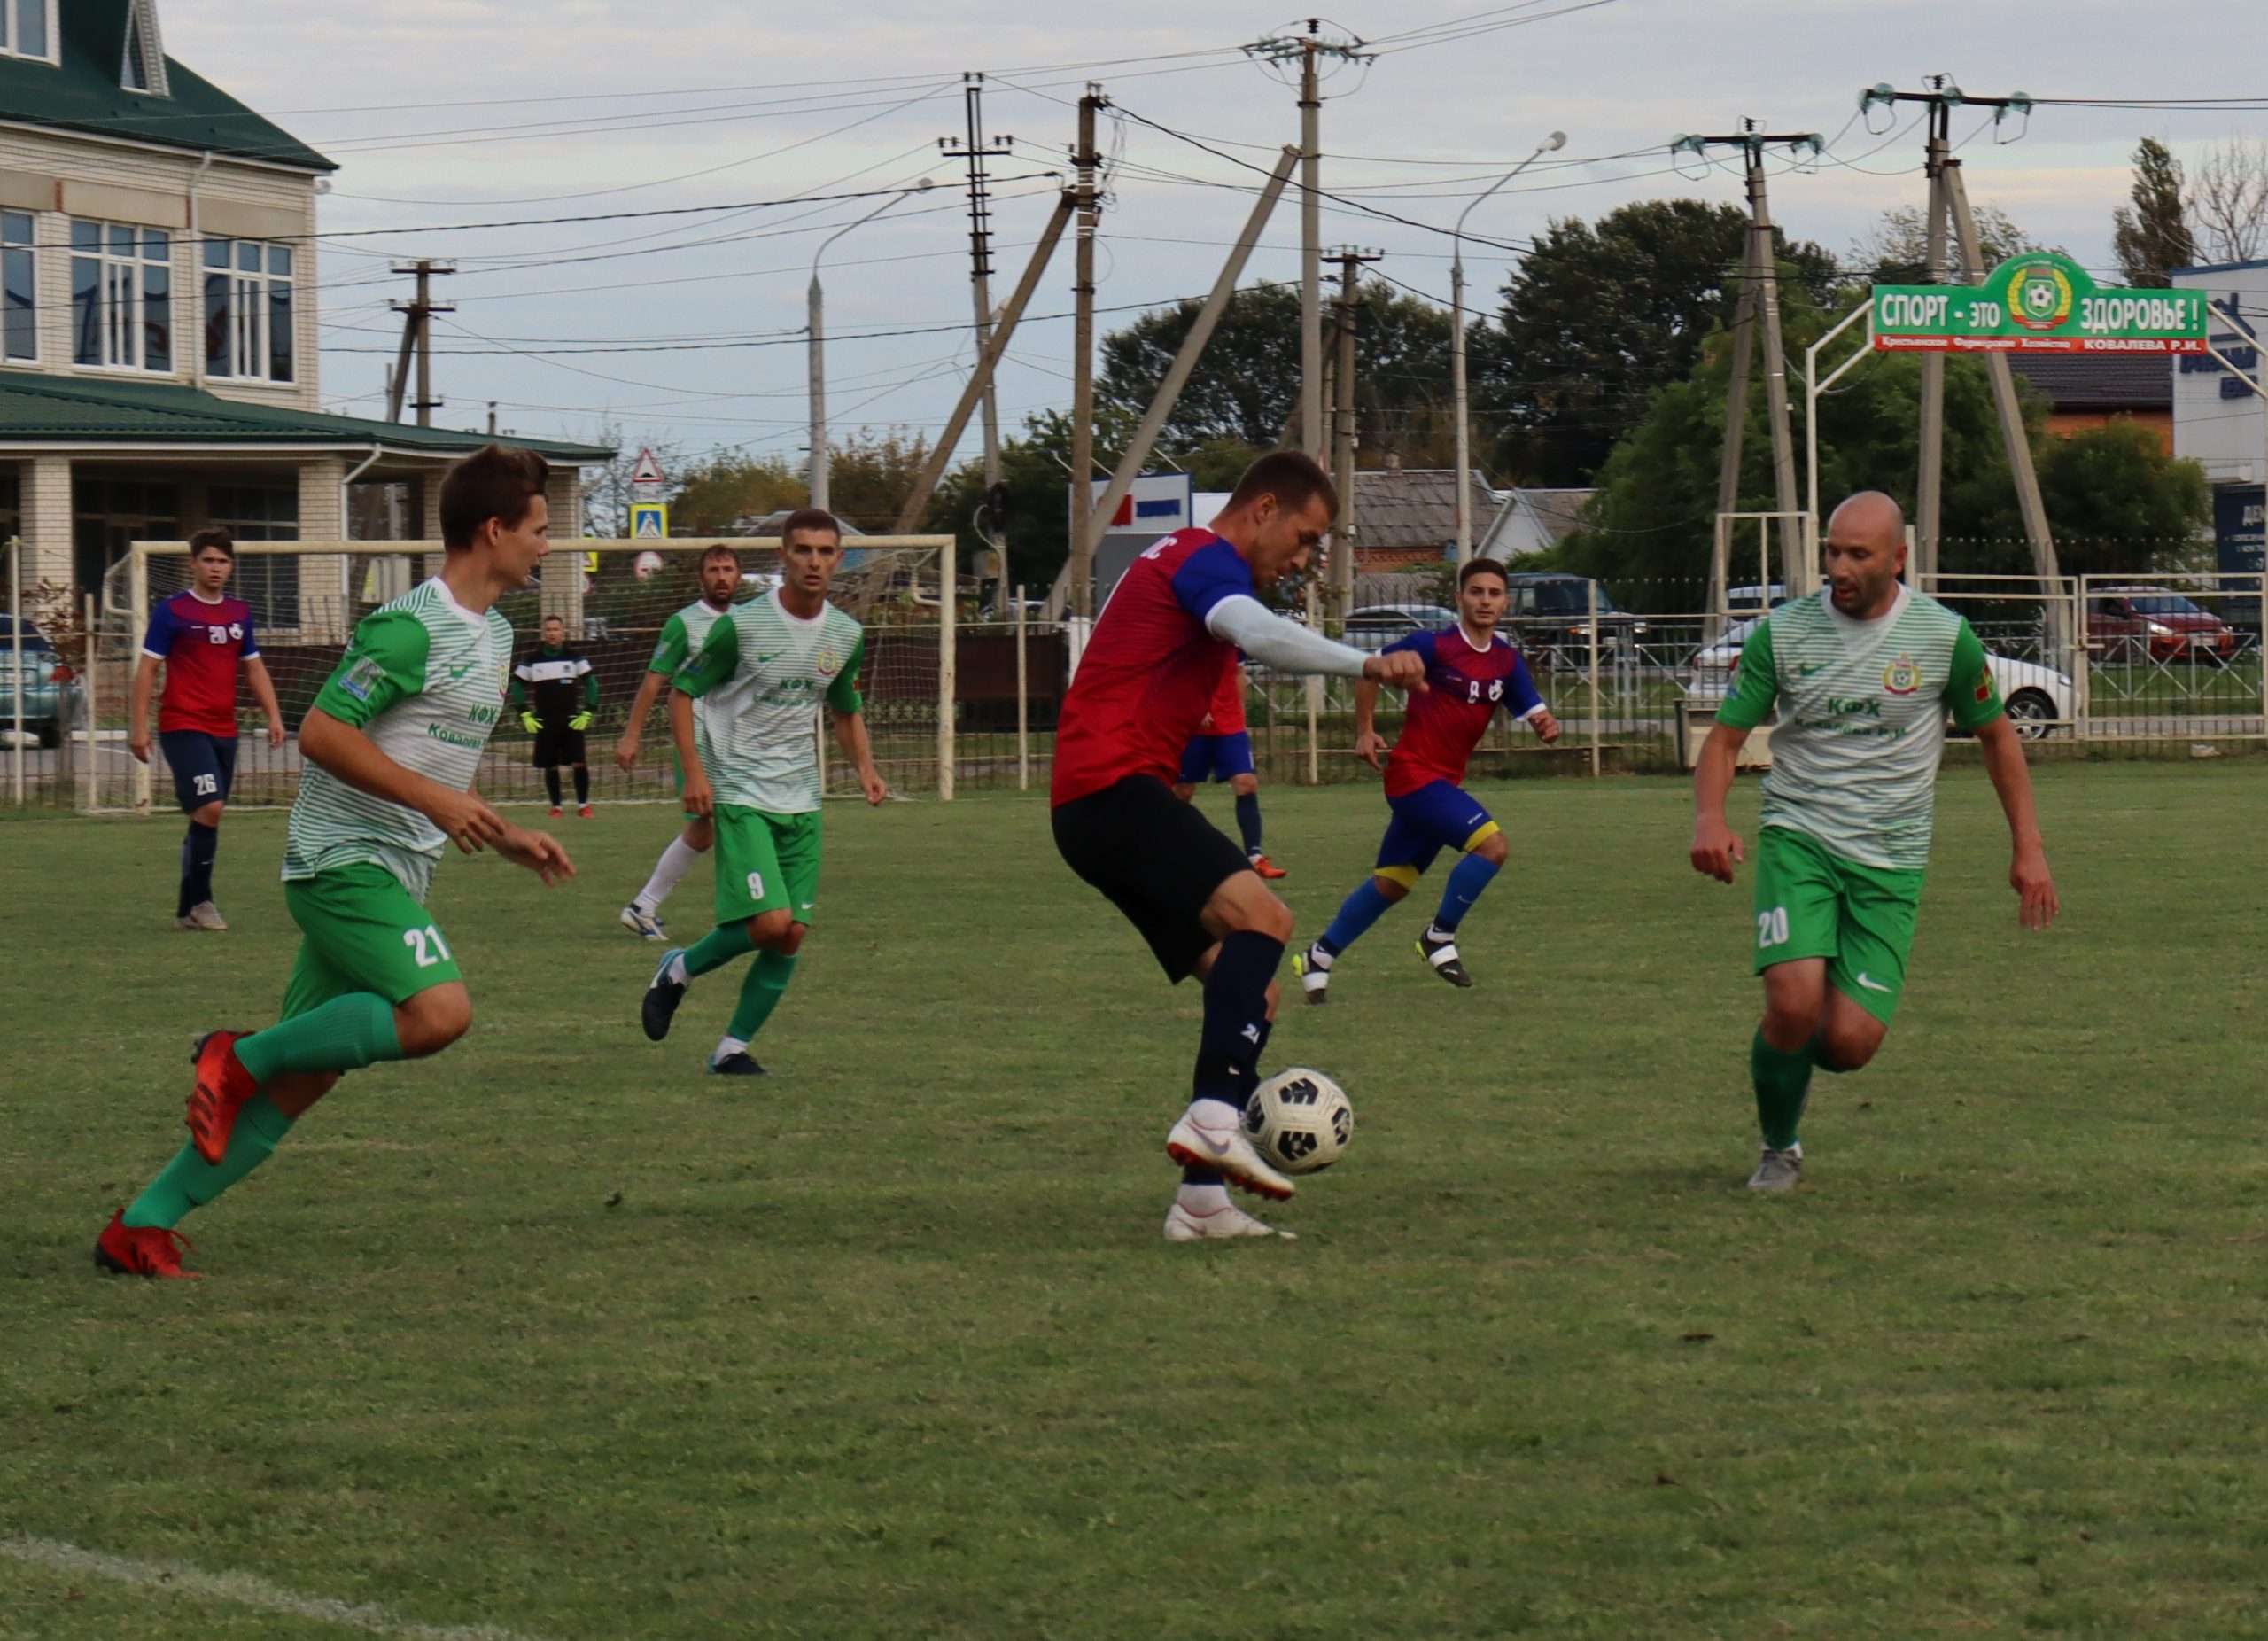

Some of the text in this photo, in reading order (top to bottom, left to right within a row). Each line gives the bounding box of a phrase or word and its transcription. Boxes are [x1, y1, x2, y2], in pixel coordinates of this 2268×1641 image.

[1881, 293, 1949, 327] СПОРТ
[1969, 301, 2000, 328] ЭТО
[2079, 298, 2186, 335] ЗДОРОВЬЕ
[2084, 339, 2167, 351] КОВАЛЕВА
[467, 703, 498, 725] КФХ
[1827, 697, 1881, 718] КФХ
[193, 774, 217, 796] 26
[747, 872, 765, 900] 9
[1758, 906, 1790, 949] 20
[403, 924, 449, 968] 21
